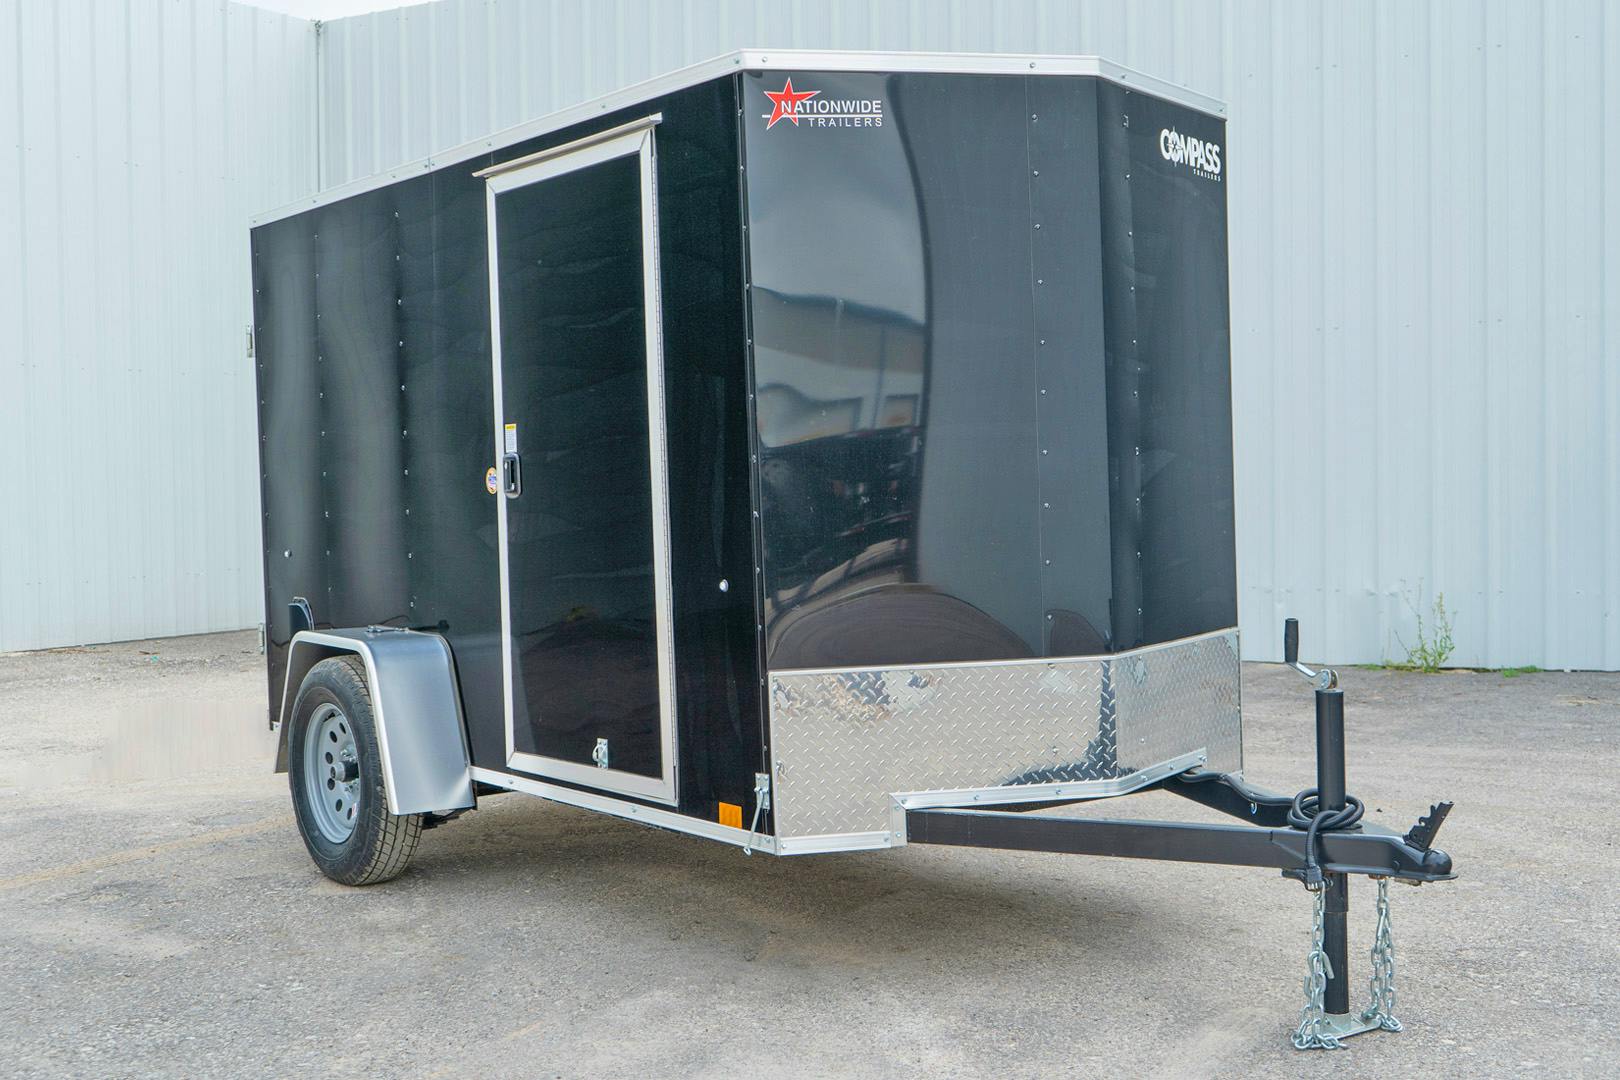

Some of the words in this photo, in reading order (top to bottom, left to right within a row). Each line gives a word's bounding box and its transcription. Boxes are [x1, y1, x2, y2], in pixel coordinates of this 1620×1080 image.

[781, 100, 882, 113] NATIONWIDE
[808, 118, 882, 127] TRAILERS
[1160, 128, 1221, 174] COMPASS
